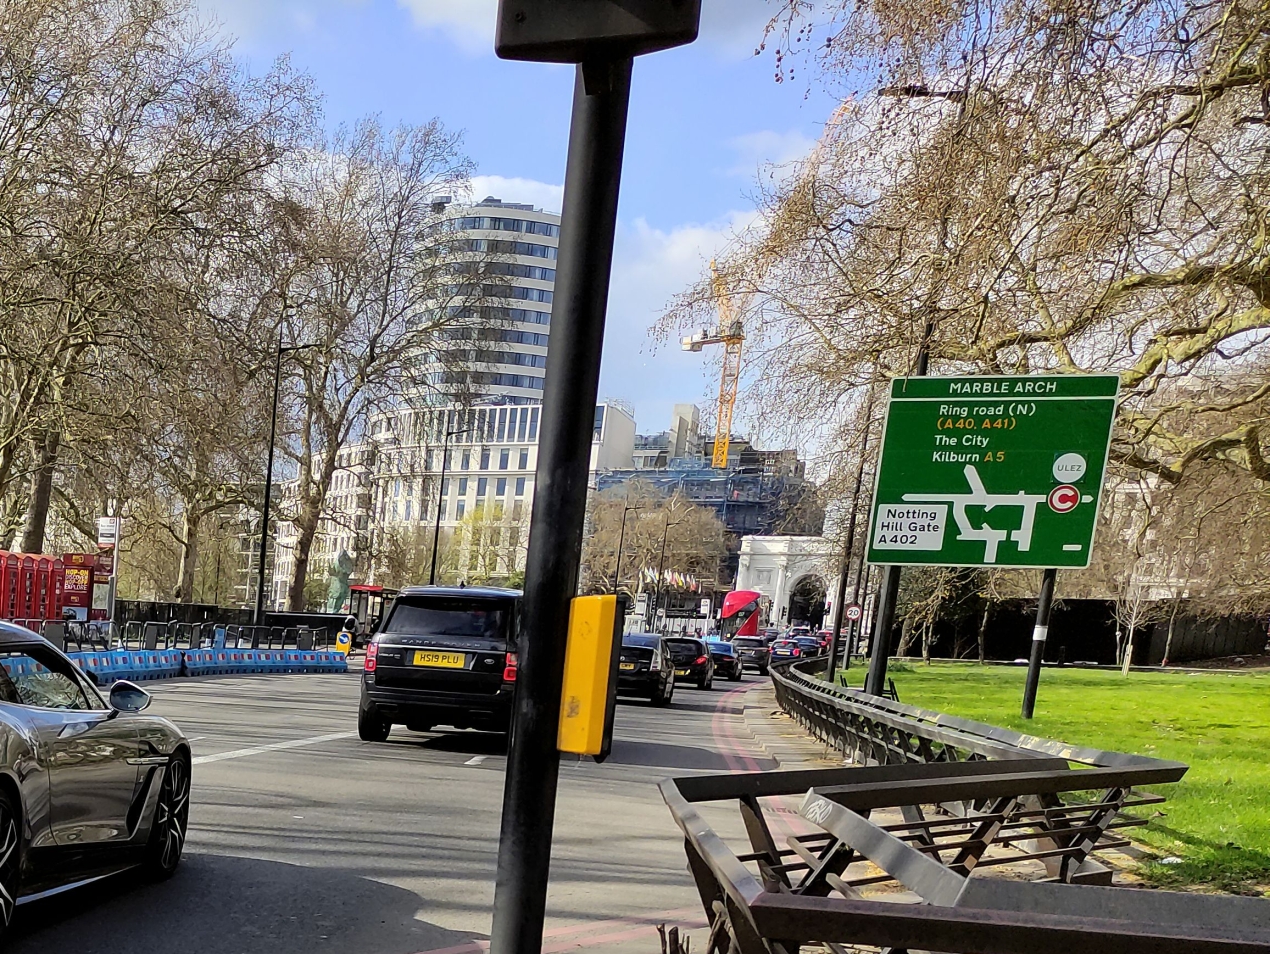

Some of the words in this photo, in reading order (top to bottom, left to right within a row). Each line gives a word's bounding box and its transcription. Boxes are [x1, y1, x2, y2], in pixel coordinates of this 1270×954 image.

[949, 382, 1010, 394] MARBLE
[1013, 381, 1057, 393] ARCH
[939, 404, 969, 417] Ring
[973, 404, 1004, 415] road
[1008, 402, 1036, 416] (N)
[981, 417, 1016, 430] A41)
[934, 435, 958, 446] The
[962, 434, 989, 448] City
[932, 451, 980, 462] Kilburn
[983, 451, 1005, 462] A5
[1057, 464, 1082, 472] ULEZ
[886, 508, 937, 521] Notting
[880, 521, 903, 532] Hill
[908, 521, 939, 532] Gate
[878, 534, 918, 545] A402
[847, 609, 859, 617] 20
[419, 653, 440, 664] HS19
[441, 654, 459, 665] PLU
